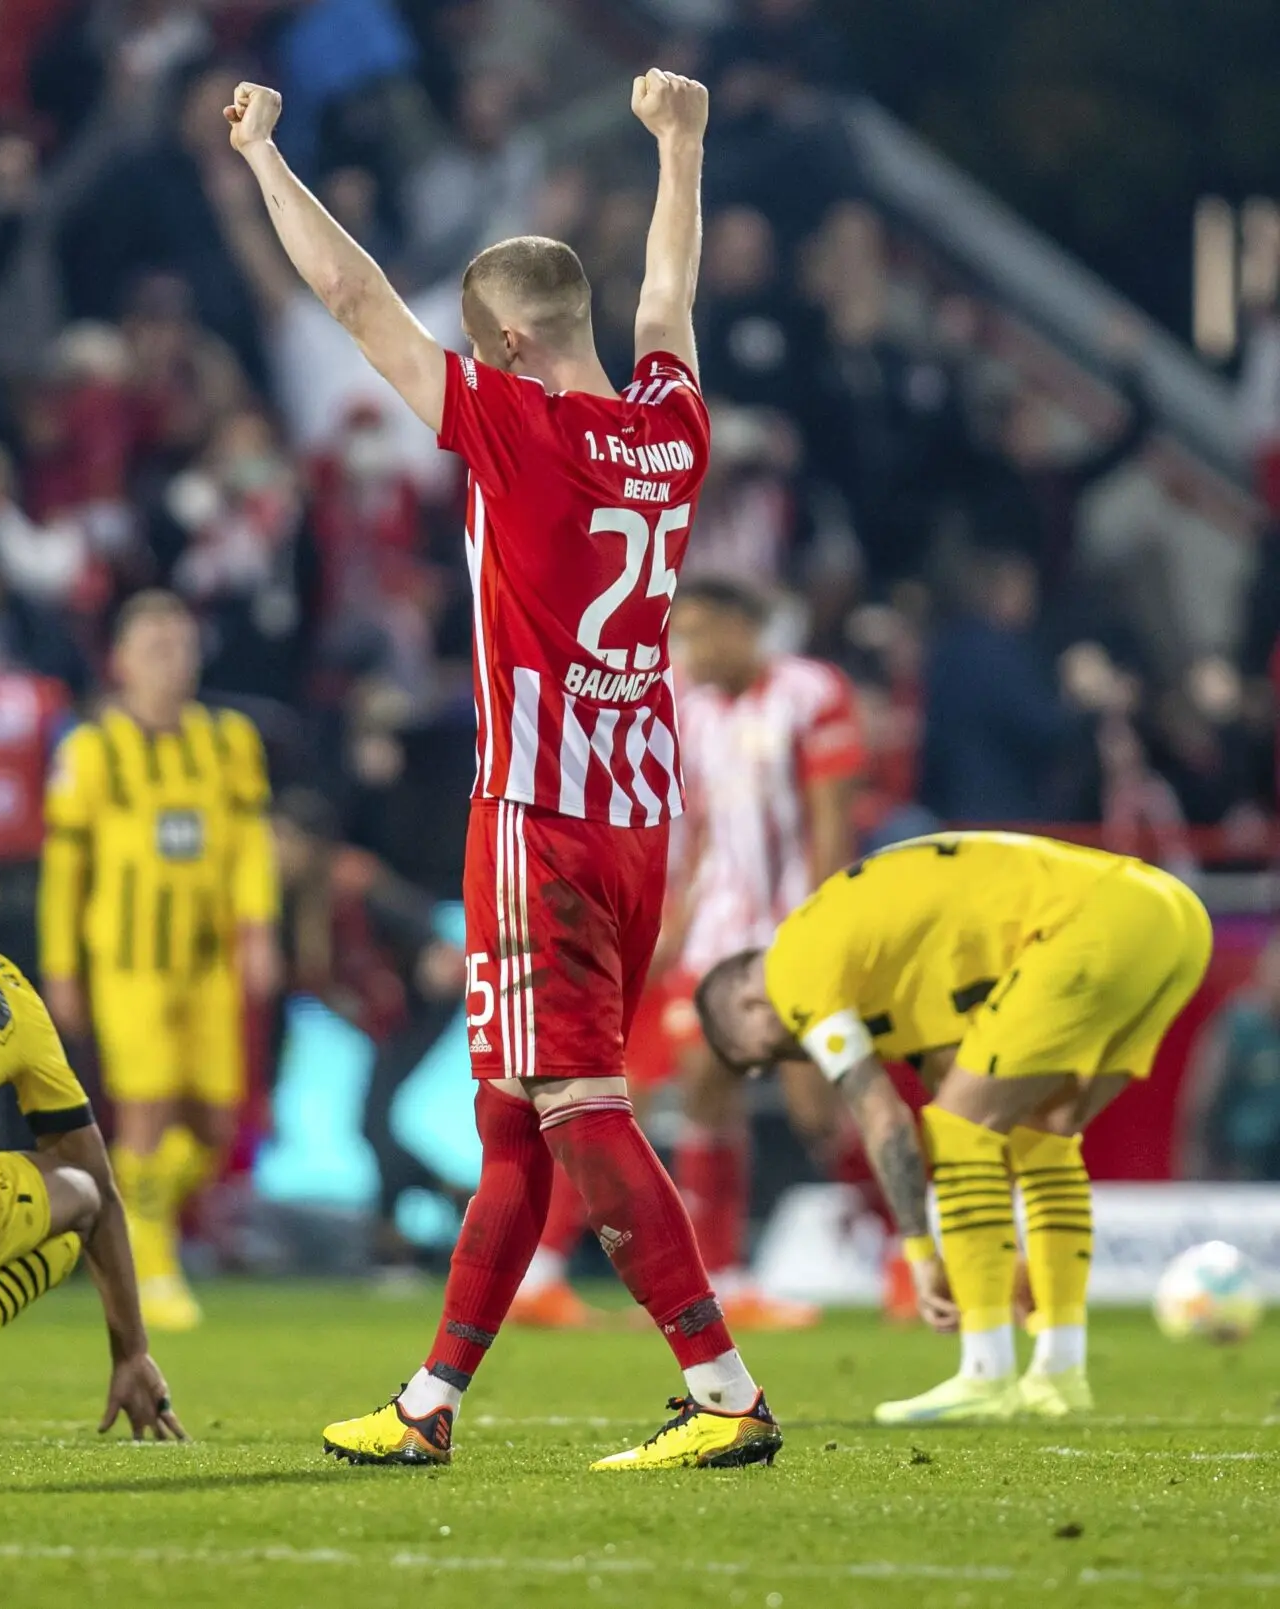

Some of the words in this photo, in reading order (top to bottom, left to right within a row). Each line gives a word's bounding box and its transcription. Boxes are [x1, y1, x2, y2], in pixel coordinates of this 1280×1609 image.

[584, 430, 605, 461] 1.
[623, 477, 670, 503] BERLIN
[576, 502, 691, 671] 25
[465, 951, 495, 1028] 5
